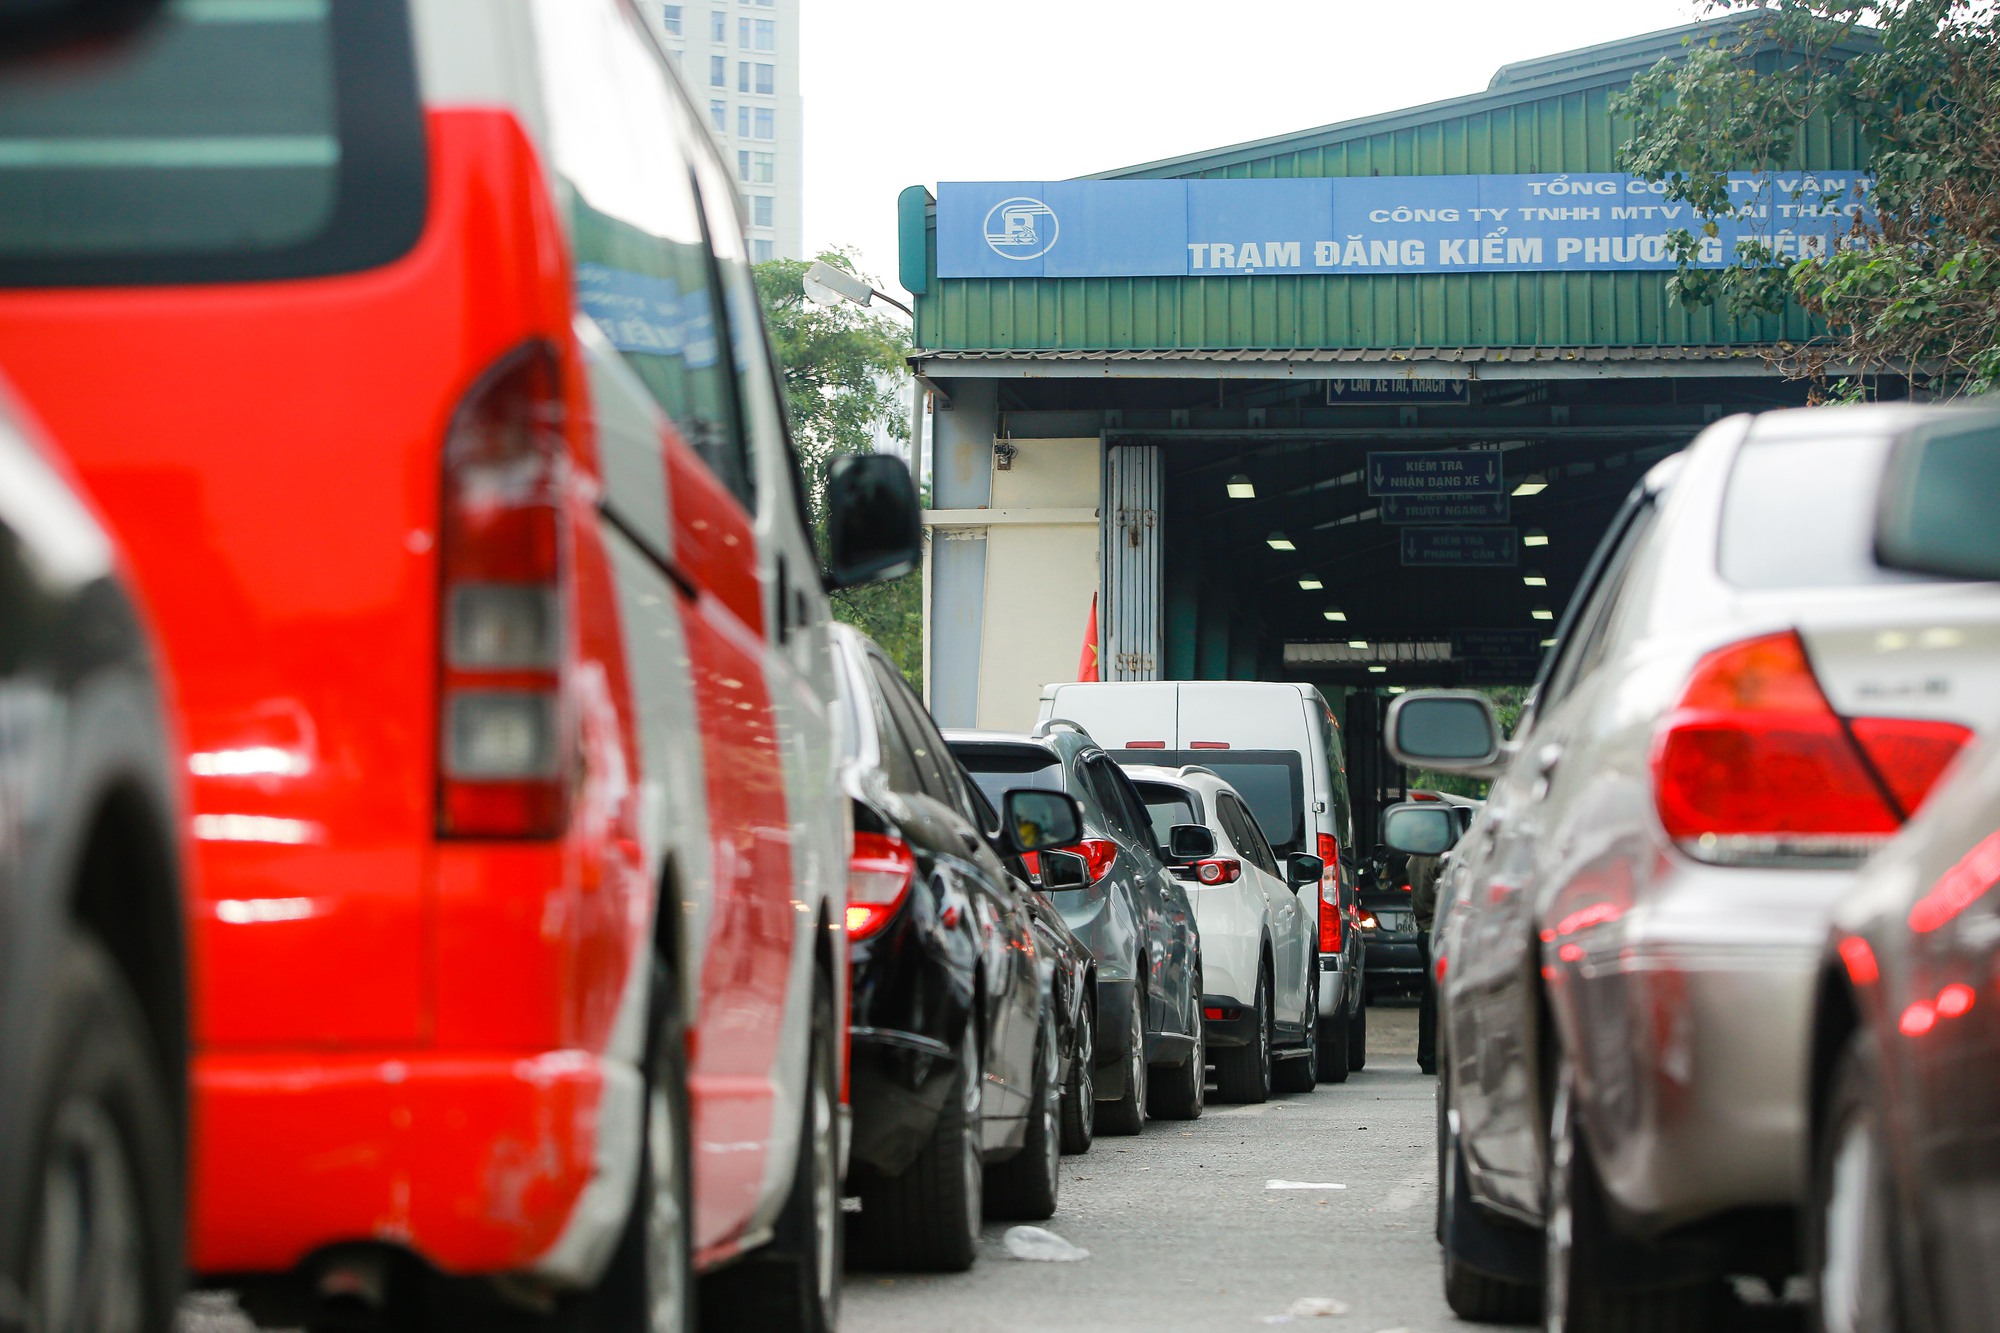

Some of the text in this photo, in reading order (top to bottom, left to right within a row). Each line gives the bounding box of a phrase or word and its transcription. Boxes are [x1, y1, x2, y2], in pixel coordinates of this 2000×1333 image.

[1528, 175, 1616, 196] TỔNG
[1727, 179, 1764, 193] TY
[1776, 175, 1846, 196] VẬN
[1369, 206, 1460, 223] CÔNG
[1468, 208, 1509, 222] TY
[1518, 207, 1600, 221] TNHH
[1611, 206, 1681, 220] MTV
[1188, 242, 1301, 273] TRẠM
[1314, 234, 1425, 267] ĐĂNG
[1439, 226, 1543, 265] KIỂM
[1440, 460, 1464, 472] TRA
[1428, 475, 1461, 489] DẠNG
[1464, 475, 1480, 486] XE
